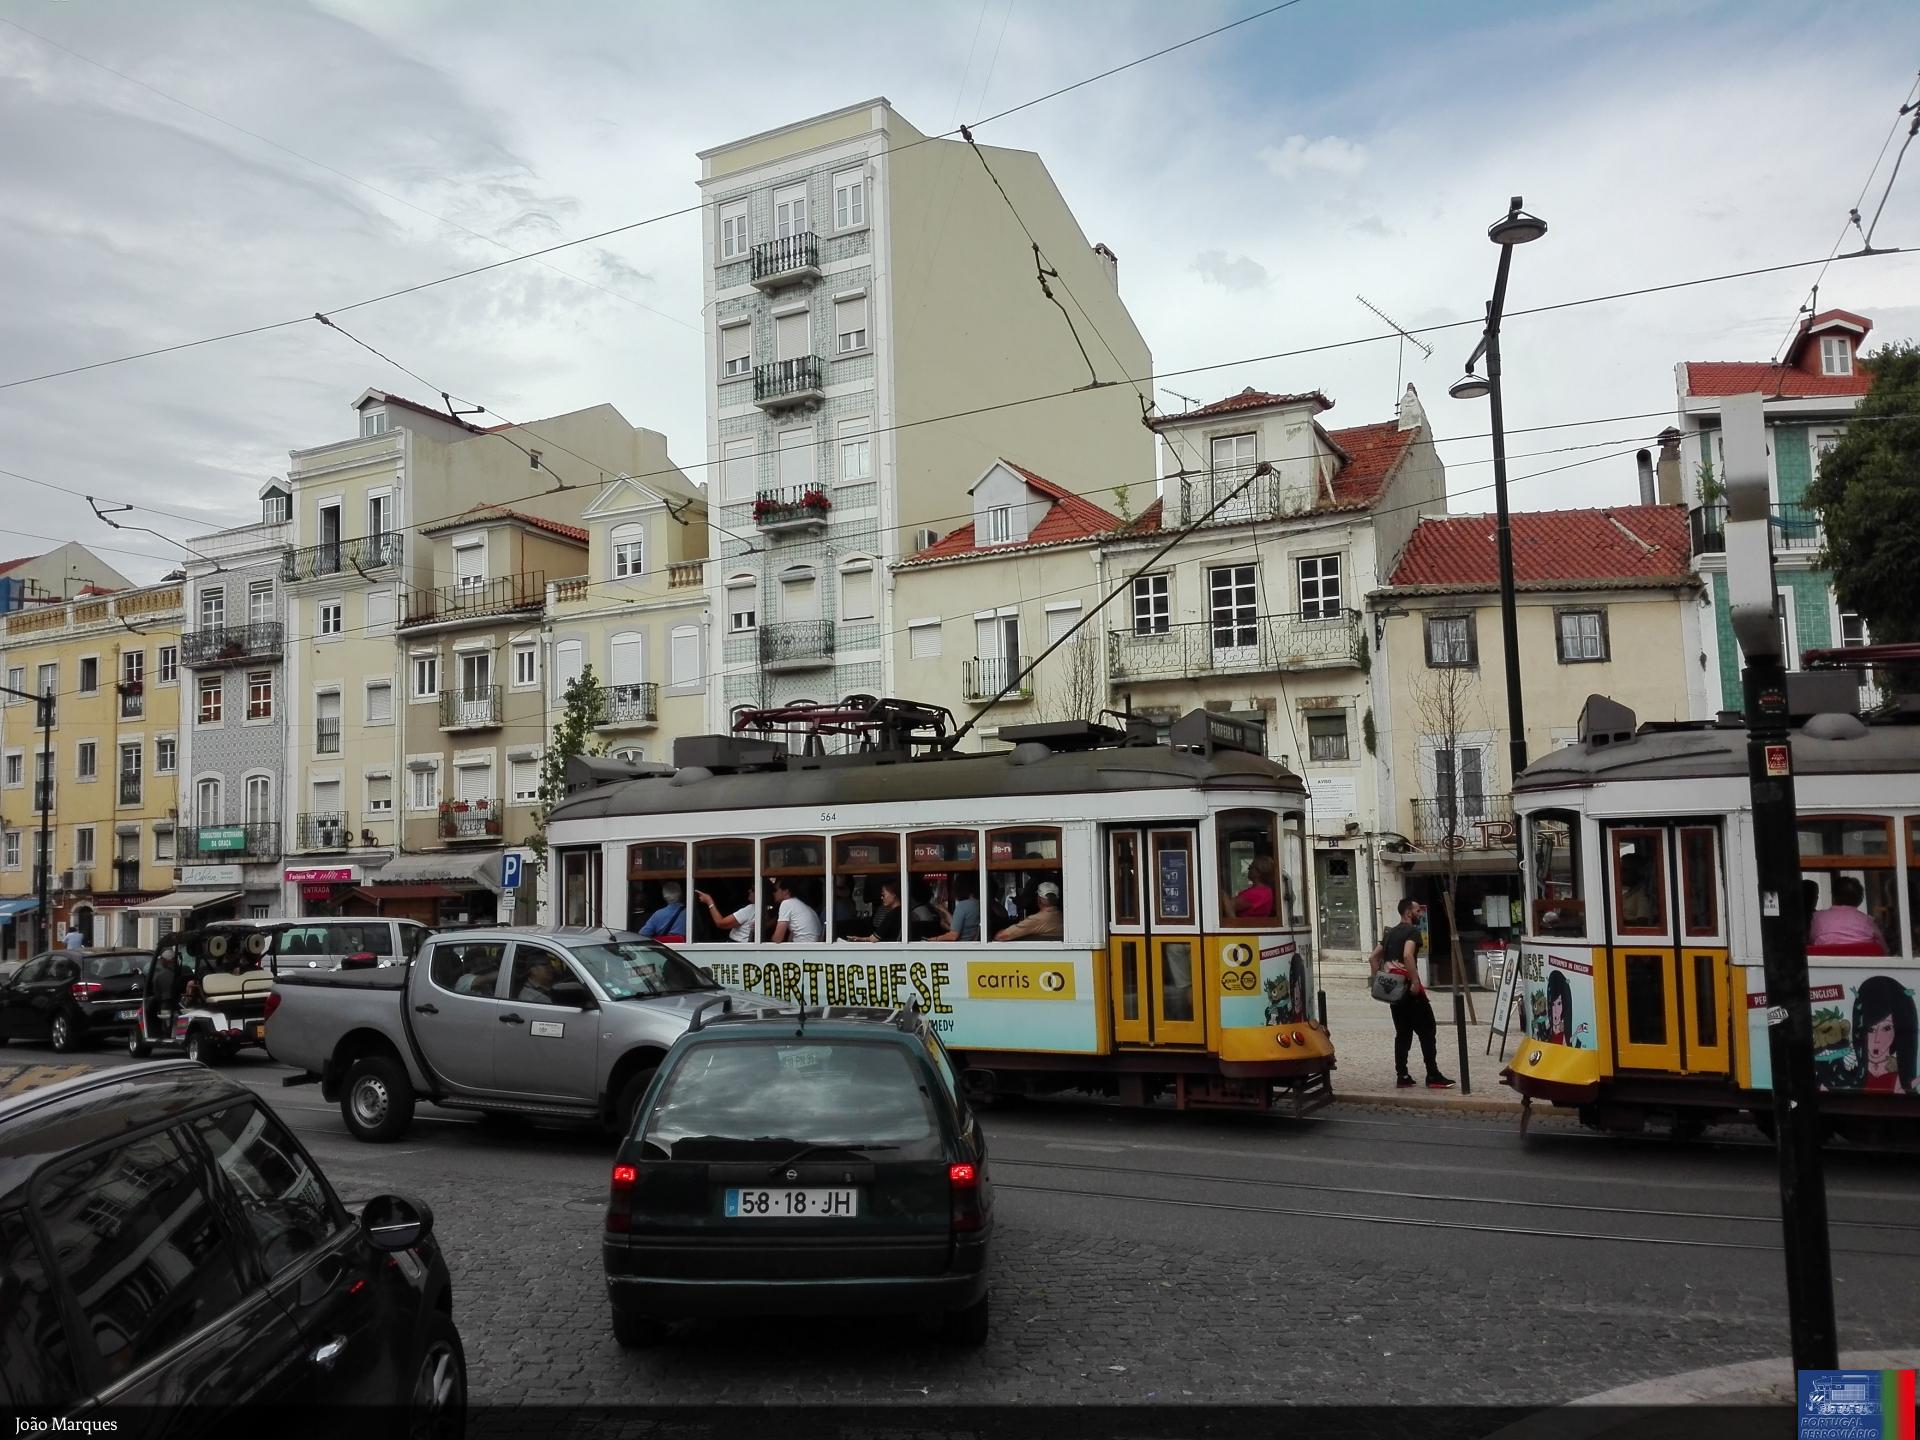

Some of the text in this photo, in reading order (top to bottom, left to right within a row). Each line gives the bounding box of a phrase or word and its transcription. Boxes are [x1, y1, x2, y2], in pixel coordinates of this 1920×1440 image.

[820, 812, 836, 822] 564
[505, 856, 517, 885] P
[303, 886, 330, 895] ENTRADA
[711, 962, 953, 1015] THE PORTUGUESE
[977, 969, 1030, 989] carris
